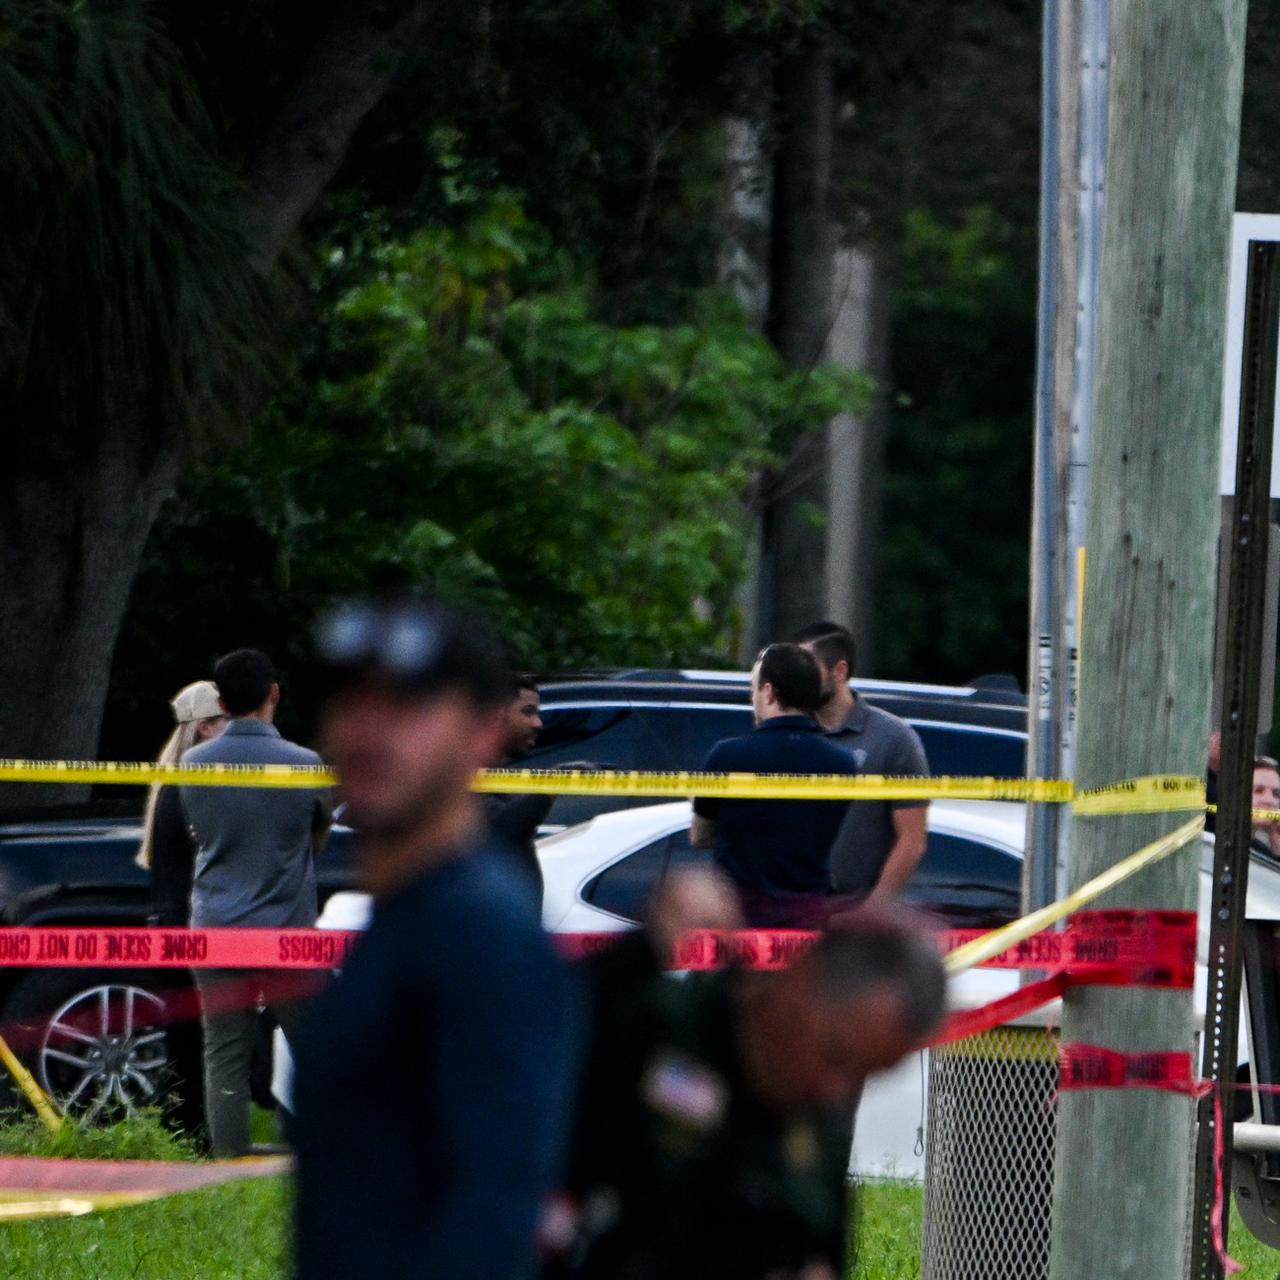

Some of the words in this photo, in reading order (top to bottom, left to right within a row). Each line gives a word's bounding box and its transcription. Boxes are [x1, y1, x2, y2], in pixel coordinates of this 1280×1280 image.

[0, 934, 30, 961] CRO
[37, 934, 69, 961] NOT
[75, 934, 97, 961] DO
[104, 934, 151, 961] SCENE
[160, 934, 207, 961] CRIME
[279, 935, 334, 962] CROSS
